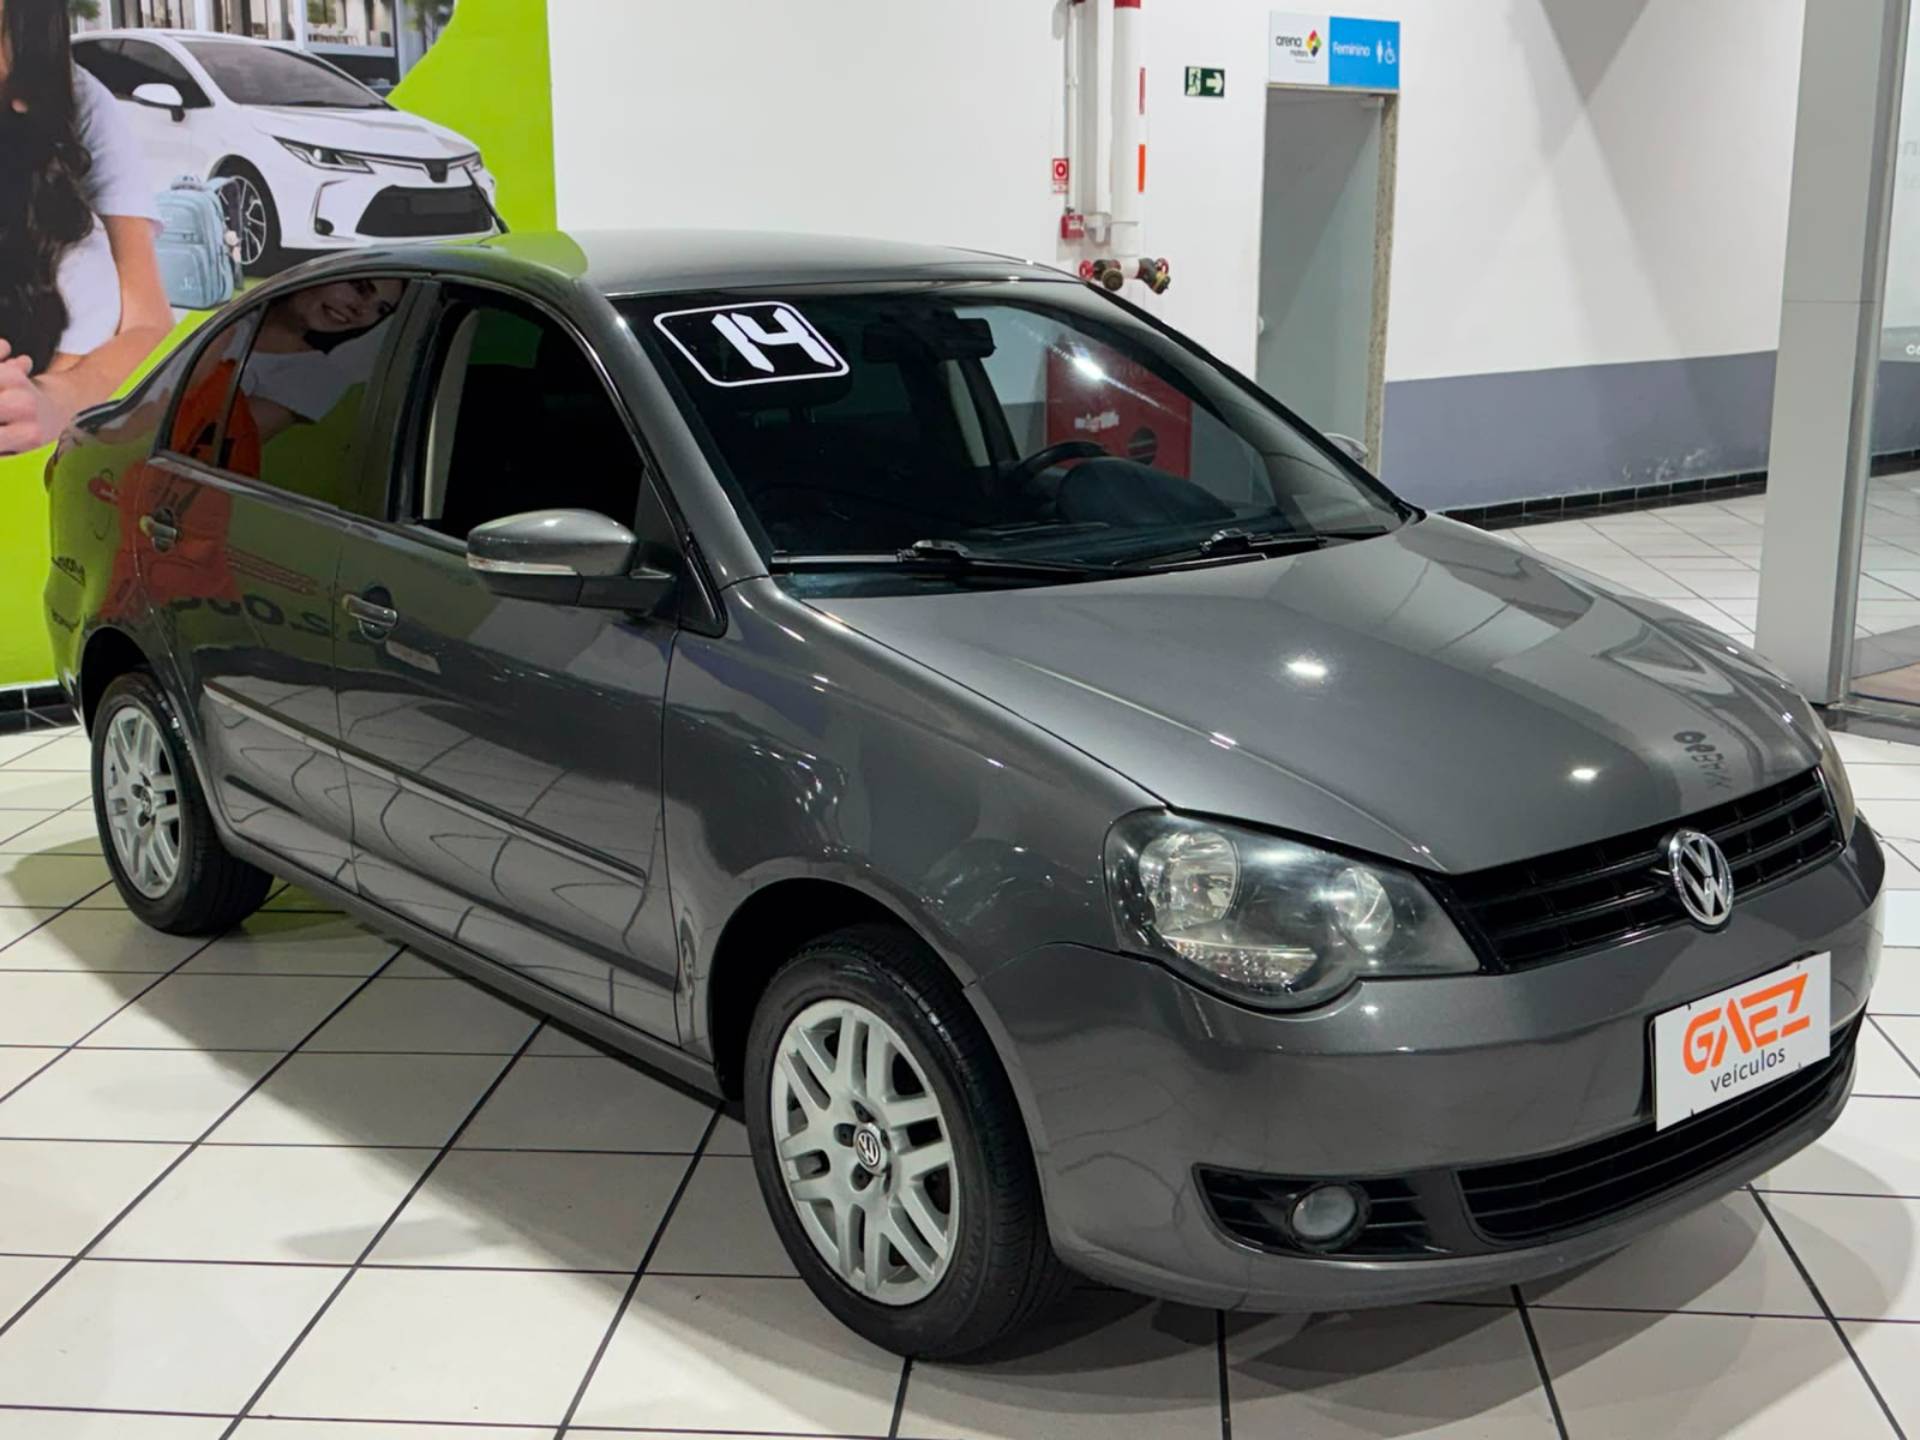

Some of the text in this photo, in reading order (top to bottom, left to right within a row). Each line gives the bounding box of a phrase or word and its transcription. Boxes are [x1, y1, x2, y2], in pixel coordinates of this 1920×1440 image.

[1276, 36, 1302, 48] arena
[1333, 41, 1370, 57] Feminino
[712, 308, 836, 373] 14
[1683, 973, 1810, 1075] GAEZ
